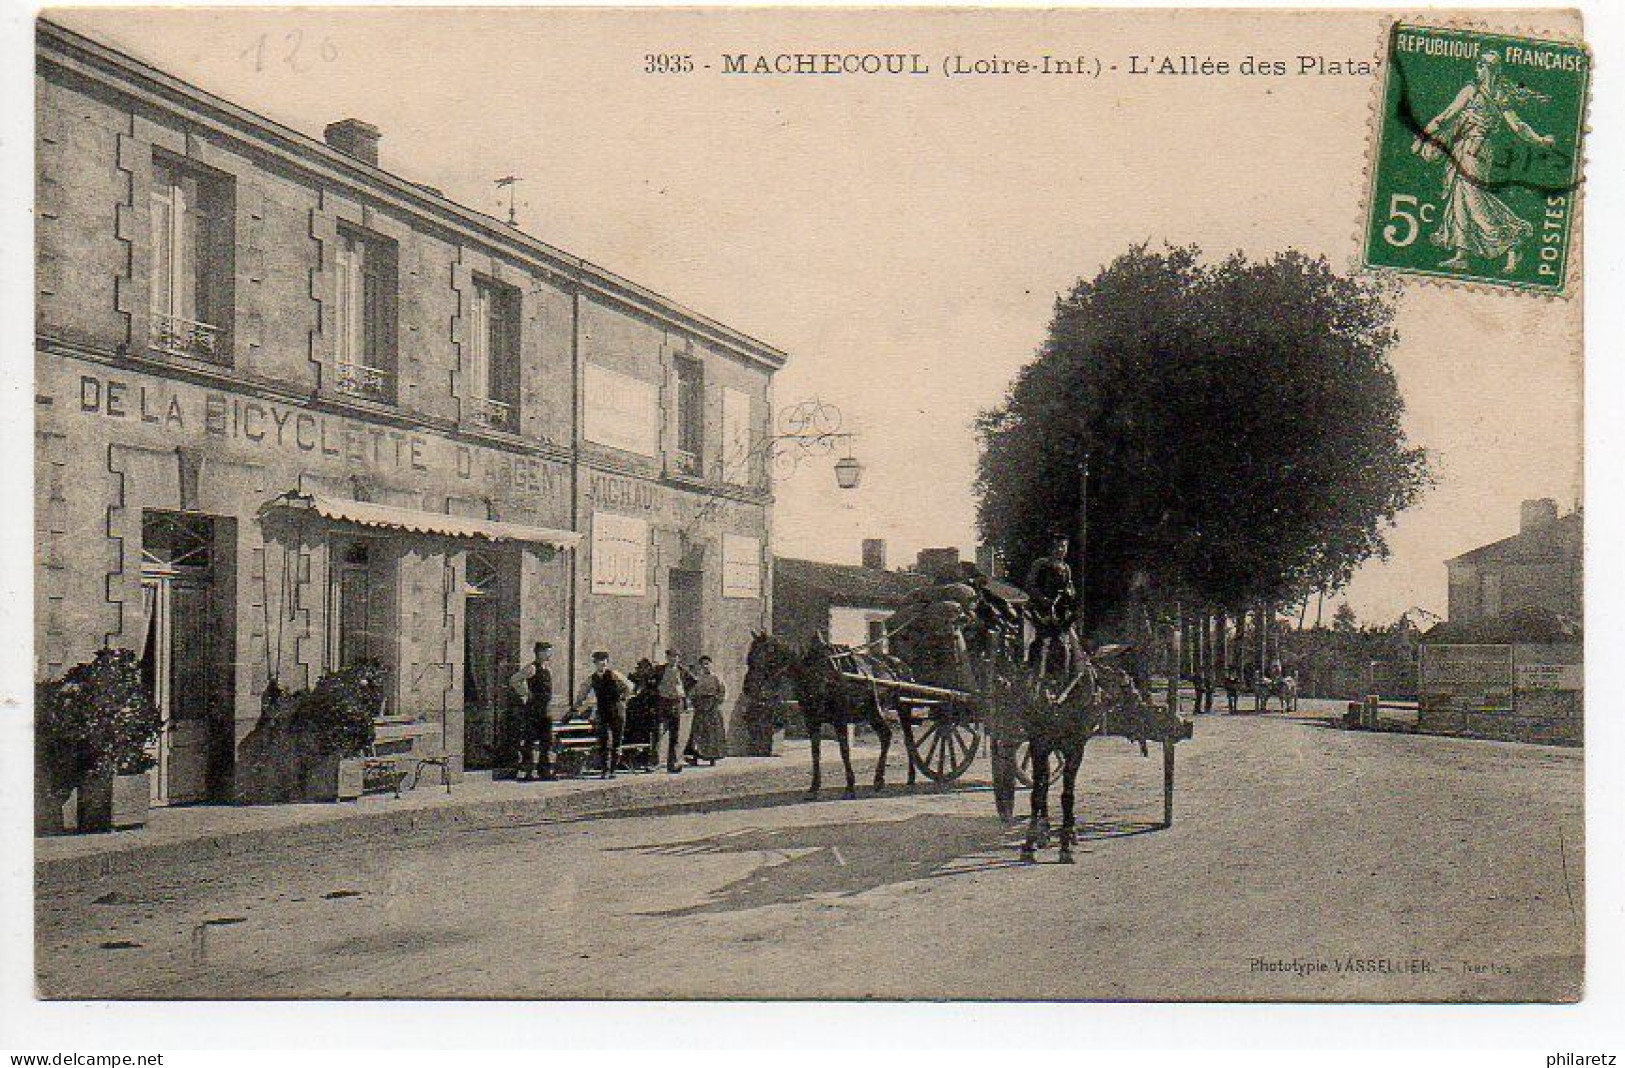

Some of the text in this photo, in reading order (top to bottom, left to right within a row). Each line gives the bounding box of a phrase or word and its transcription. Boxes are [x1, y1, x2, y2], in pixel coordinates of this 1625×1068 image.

[1506, 46, 1583, 72] FRANÇAISE
[1538, 195, 1566, 276] POSTES
[79, 375, 126, 418] DE
[139, 386, 184, 428] LA
[204, 393, 430, 471] BICYCLETTE
